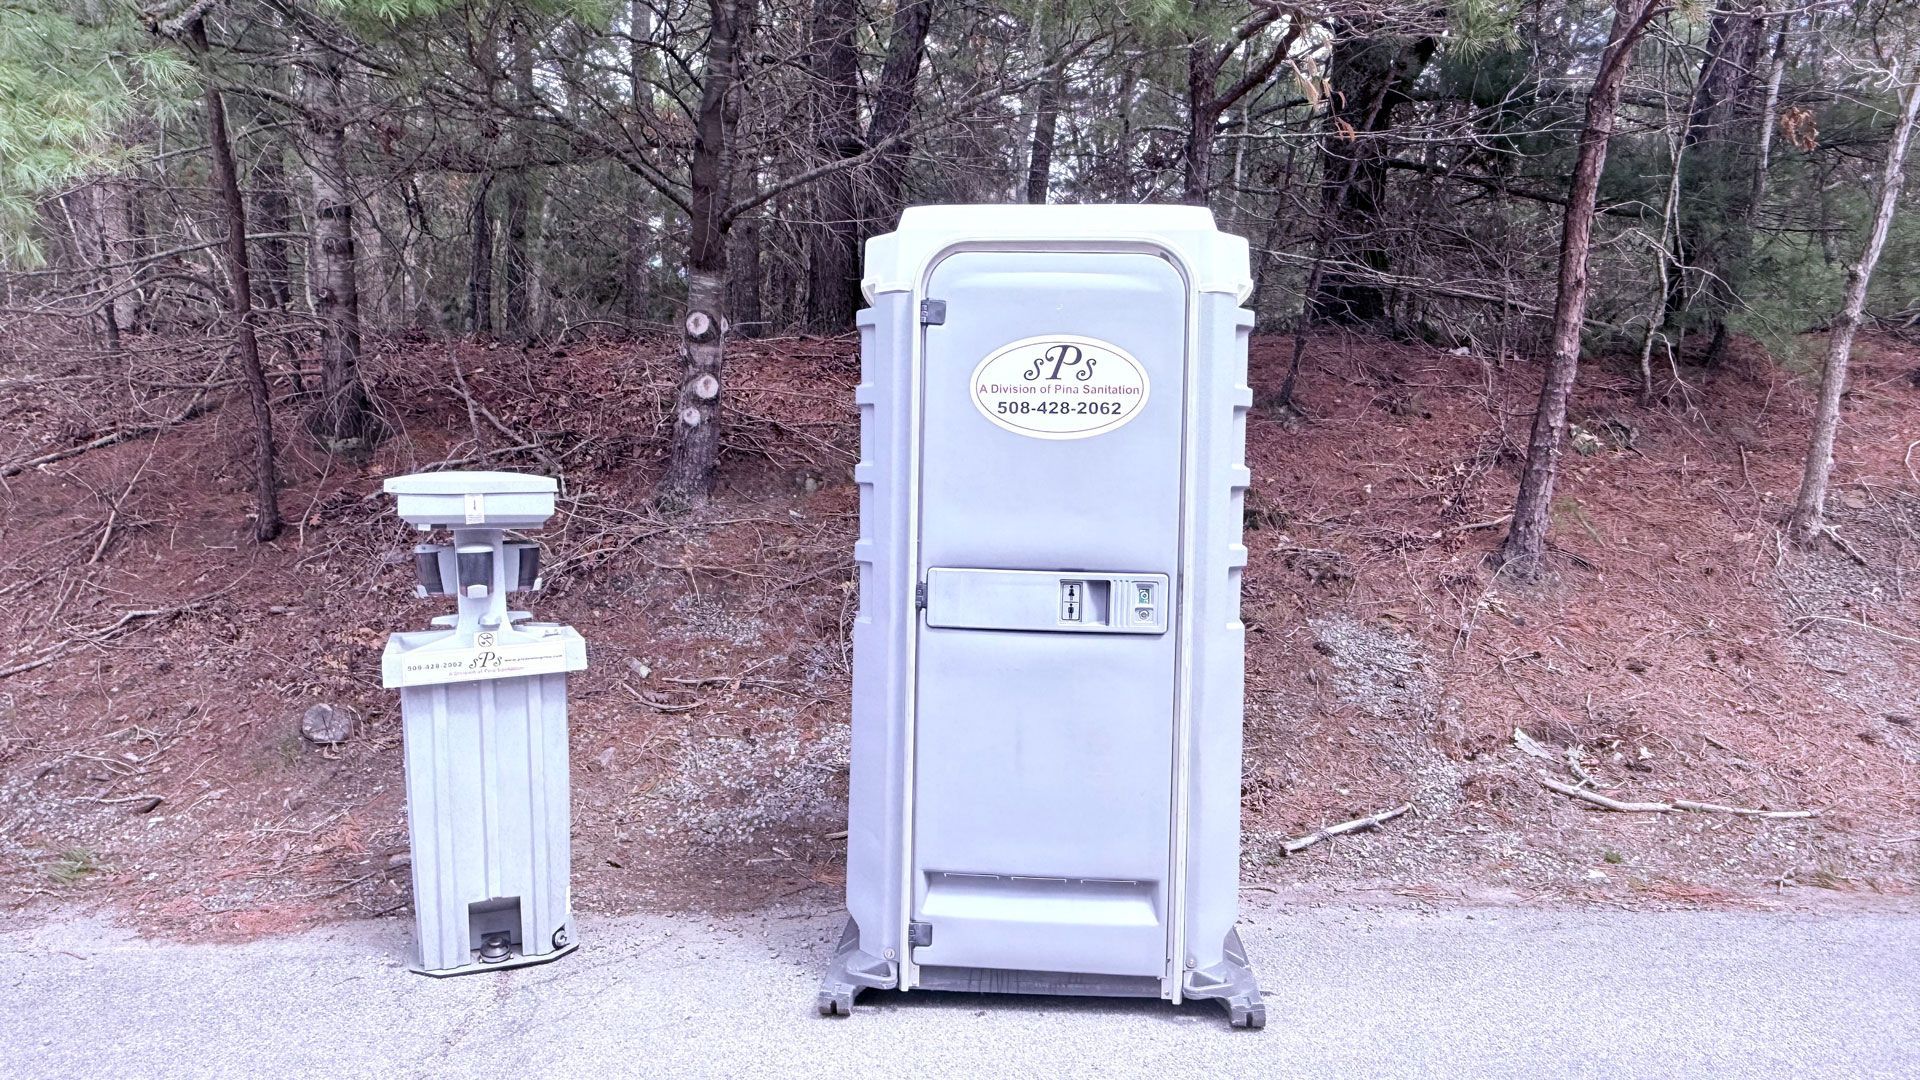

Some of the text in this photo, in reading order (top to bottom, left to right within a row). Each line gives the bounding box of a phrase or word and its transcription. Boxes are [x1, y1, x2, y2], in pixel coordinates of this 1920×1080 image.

[979, 384, 1140, 395] A Division of Pina Sanitation
[997, 401, 1121, 415] 508-428-2062
